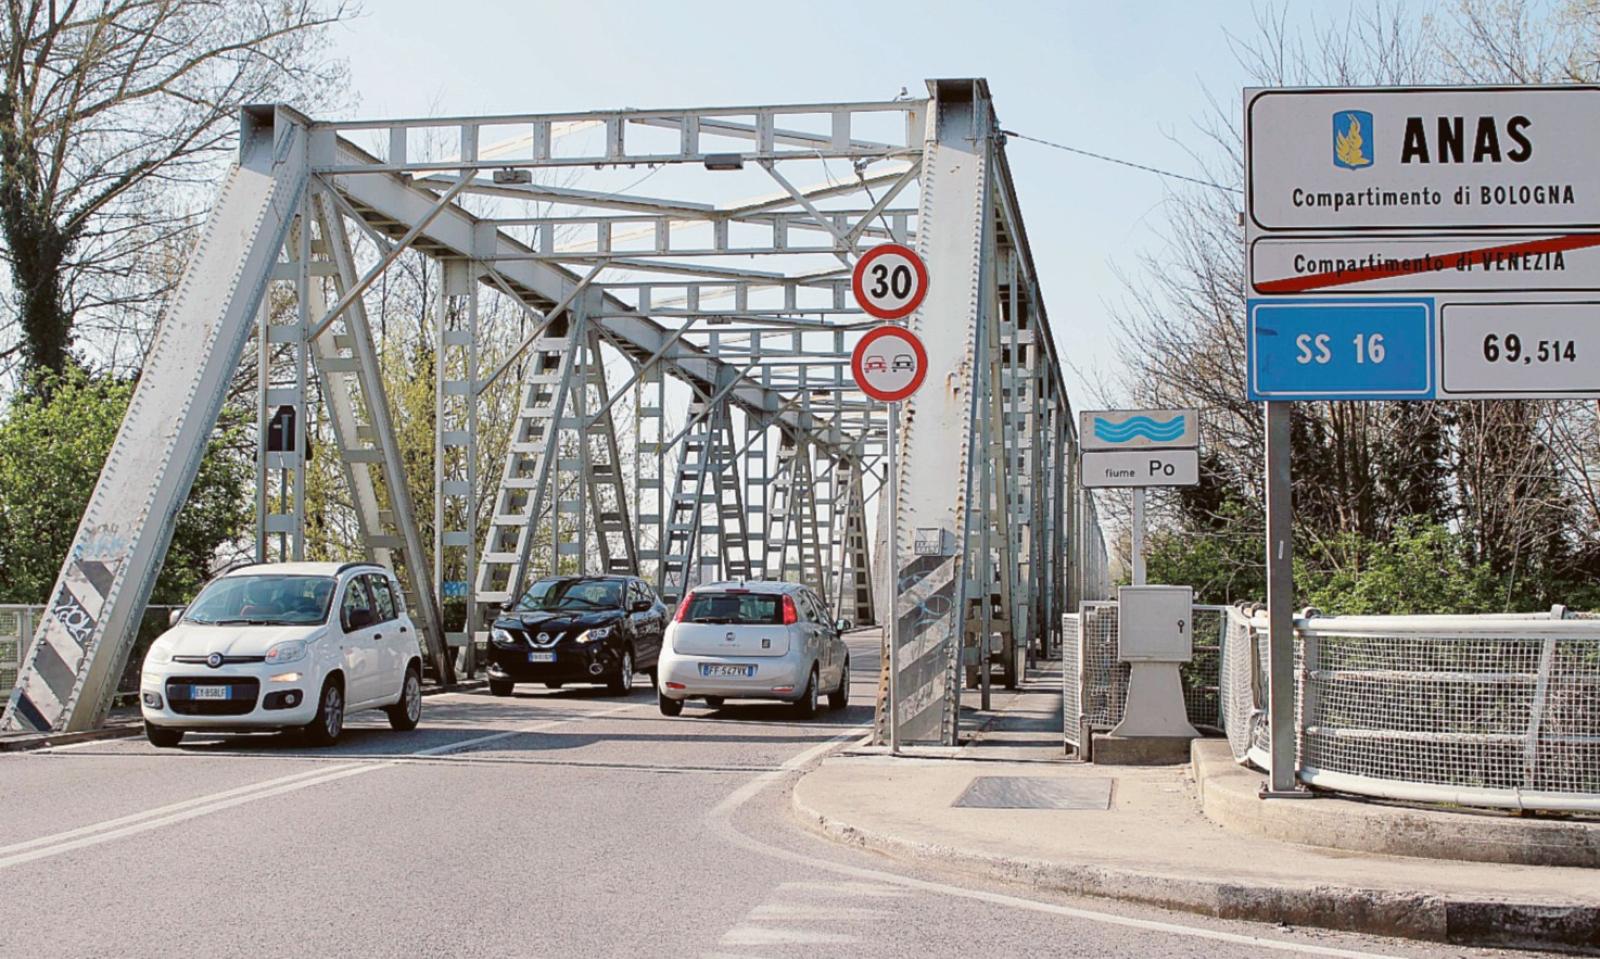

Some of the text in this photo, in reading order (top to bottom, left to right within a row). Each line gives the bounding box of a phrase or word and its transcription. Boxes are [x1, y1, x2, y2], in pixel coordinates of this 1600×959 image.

[1401, 115, 1532, 163] ANAS
[1292, 185, 1575, 211] Compartimento di BOLOGNA
[1293, 251, 1565, 277] Compartimento di VENEZIA
[870, 264, 912, 299] 30
[1295, 333, 1386, 364] SS 16
[1483, 333, 1576, 365] 69,514
[1105, 460, 1175, 478] fiume Po
